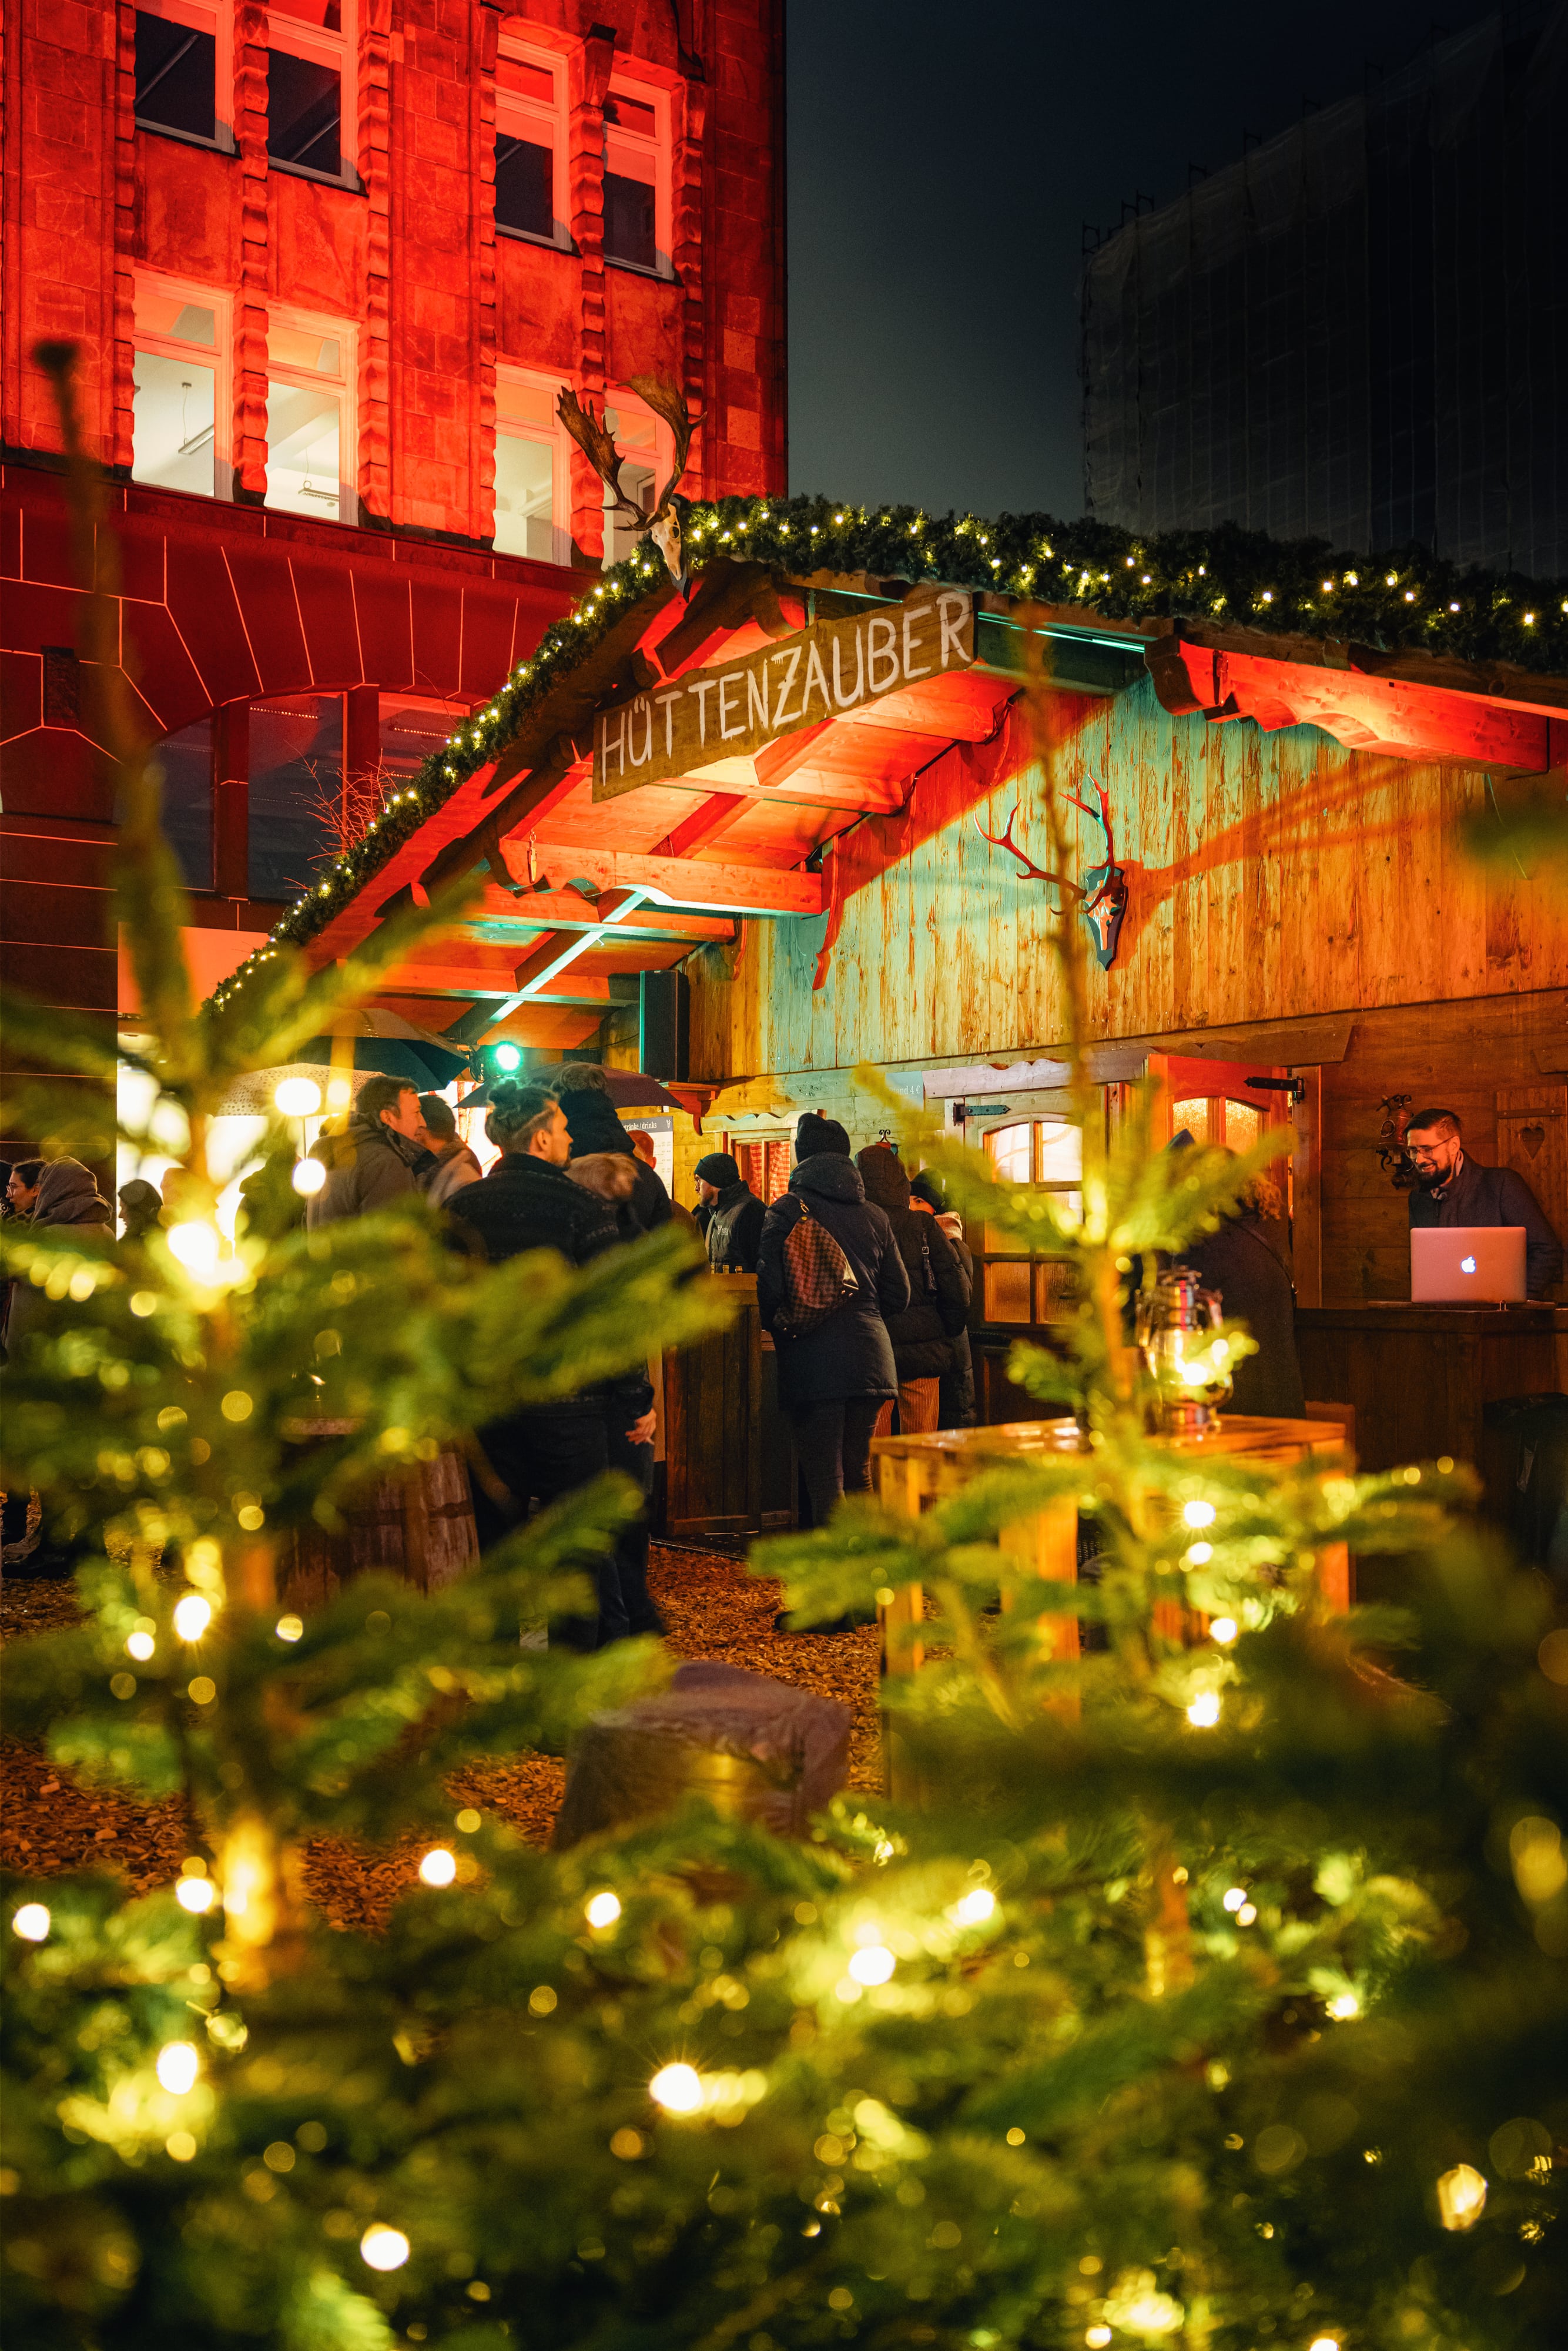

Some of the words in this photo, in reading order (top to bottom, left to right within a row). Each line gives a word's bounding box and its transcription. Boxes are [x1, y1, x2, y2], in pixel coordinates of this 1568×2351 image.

[602, 592, 973, 787] HÜTTENZAUBER
[910, 1086, 914, 1094] 4
[916, 1085, 920, 1094] €
[642, 1121, 657, 1129] drinks
